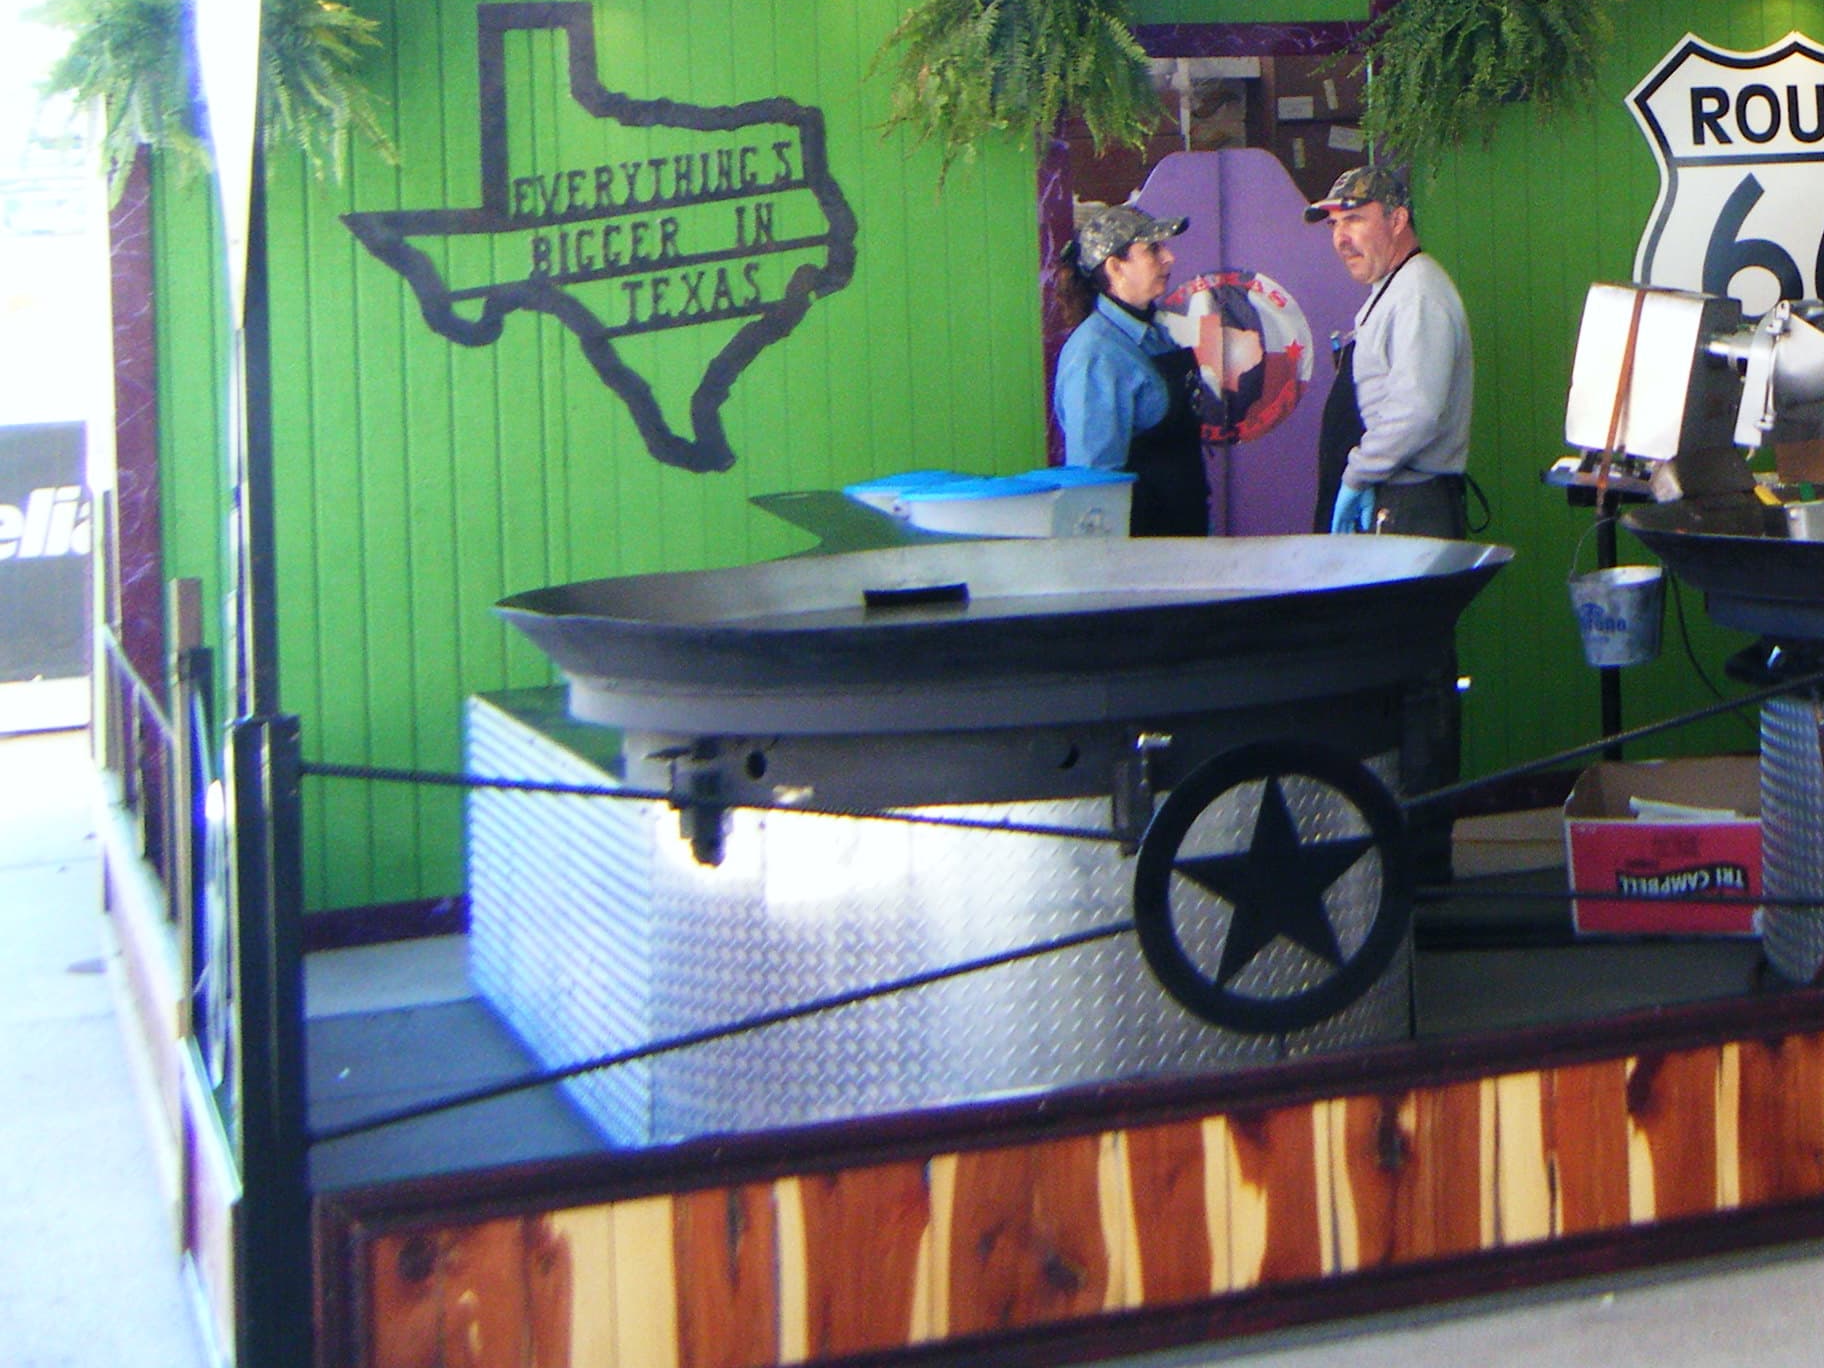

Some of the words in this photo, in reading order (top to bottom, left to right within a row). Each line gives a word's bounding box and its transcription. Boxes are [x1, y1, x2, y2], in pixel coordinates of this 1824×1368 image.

[531, 215, 681, 280] BIGGER
[734, 201, 775, 249] IN
[621, 262, 763, 330] TEXAS
